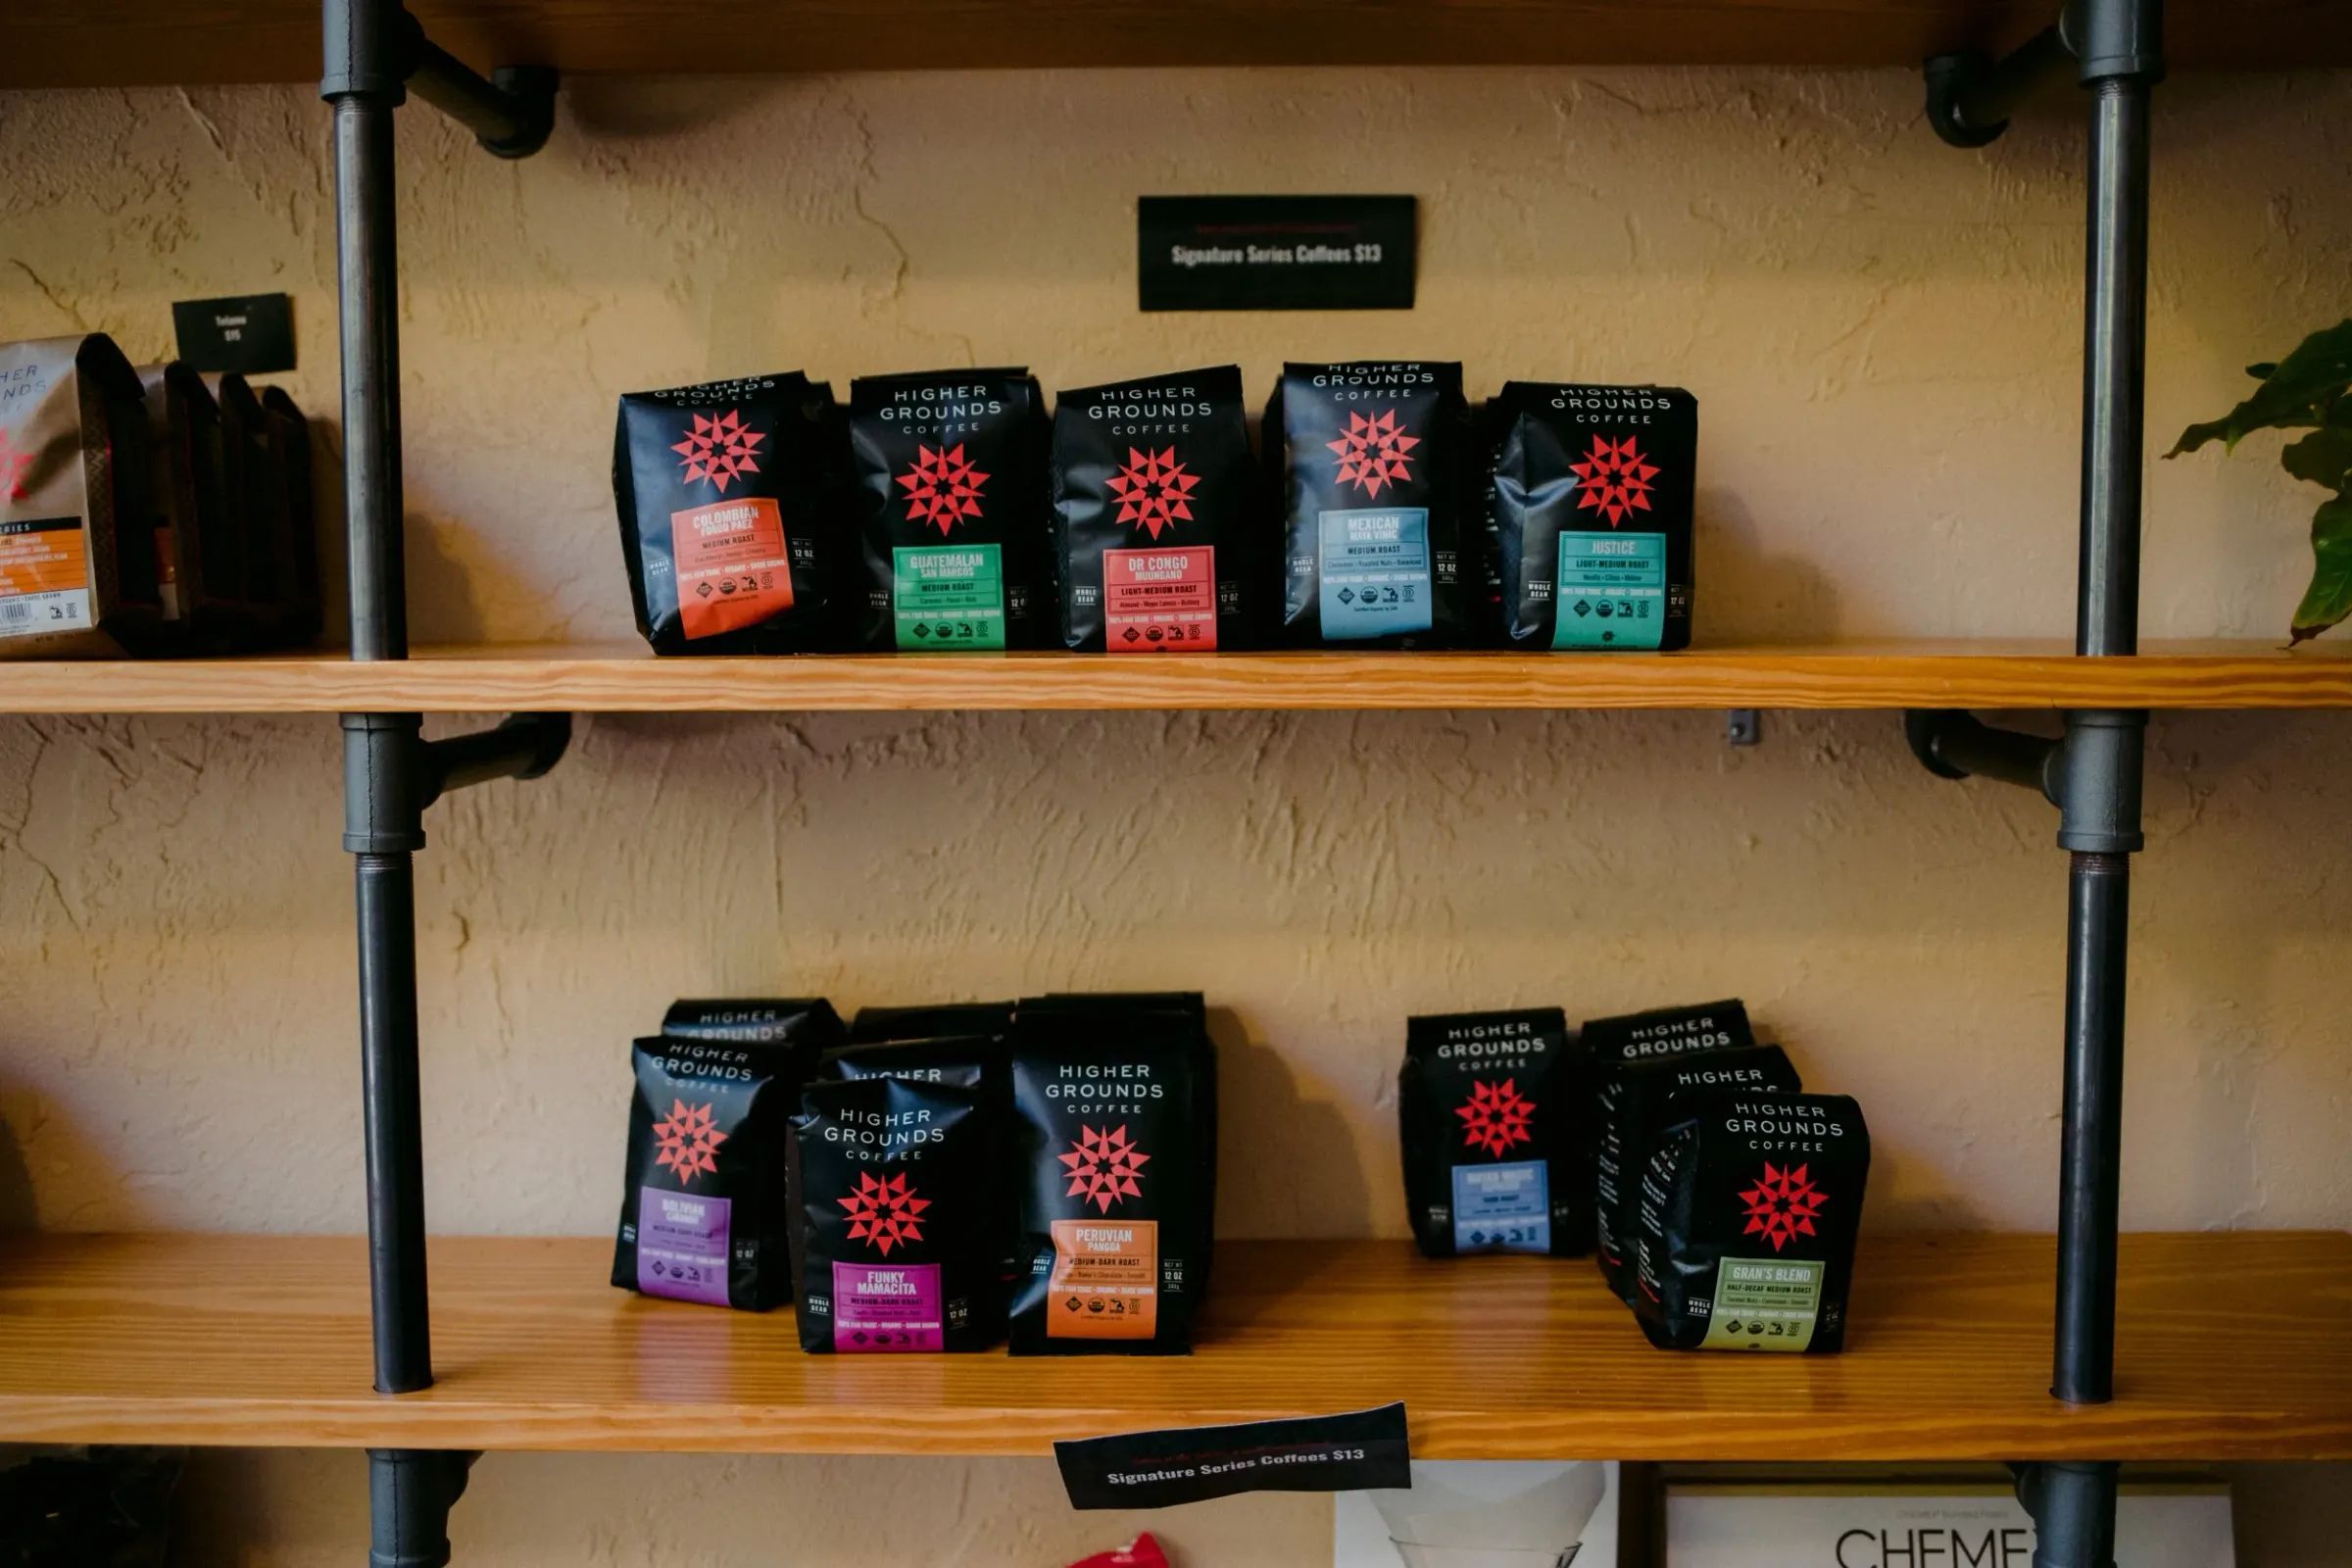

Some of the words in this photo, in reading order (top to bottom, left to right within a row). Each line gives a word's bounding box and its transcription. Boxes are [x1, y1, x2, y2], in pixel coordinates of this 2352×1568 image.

[1172, 246, 1244, 268] Signature
[1247, 245, 1292, 263] Series
[1296, 245, 1350, 263] Coffees
[1354, 244, 1381, 263] $13
[1328, 365, 1420, 374] HIGHER
[678, 376, 760, 391] GHER
[1313, 373, 1434, 387] GROUNDS
[655, 380, 775, 398] GROUNDS
[895, 385, 987, 402] HIGHER
[1102, 387, 1196, 400] HIGHER
[1335, 389, 1411, 401] COFFEE
[677, 393, 753, 406] COFFEE
[1551, 398, 1671, 410] GROUNDS
[880, 401, 1002, 420] GROUNDS
[1088, 403, 1211, 419] GROUNDS
[1576, 415, 1651, 423] COFFEE
[903, 422, 979, 434] COFFEE
[1112, 423, 1191, 435] COFFEE
[692, 507, 760, 528] COLOMBIAN
[731, 518, 754, 531] PAEZ
[1348, 516, 1399, 531] MEXICAN
[703, 538, 730, 549] MEDIUM
[732, 535, 755, 545] ROAST
[1591, 541, 1637, 555] JUSTICE
[804, 549, 813, 558] OZ
[1348, 546, 1376, 555] MEDIUM
[1378, 545, 1400, 554] ROAST
[910, 554, 983, 568] GUATEMALAN
[1129, 558, 1144, 571] DR
[1148, 556, 1188, 570] CONGO
[1438, 564, 1446, 572] 12
[1447, 564, 1456, 572] OZ
[1576, 560, 1627, 568] LIGHT-MEDIUM
[1628, 561, 1649, 569] ROAST
[939, 566, 974, 577] MARCOS
[921, 583, 951, 592] MEDIUM
[953, 582, 974, 591] ROAST
[1121, 586, 1173, 596] LIGHT-MEDIUM
[1175, 585, 1198, 594] ROAST
[1011, 599, 1019, 608] 12
[1220, 594, 1228, 603] 12
[700, 1010, 776, 1024] HIGHER
[1448, 1022, 1531, 1040] HIGHER
[1632, 1017, 1714, 1040] HIGHER
[1438, 1038, 1545, 1058] GROUNDS
[1623, 1032, 1731, 1057] GROUNDS
[669, 1045, 749, 1062] HIGHER
[651, 1055, 753, 1082] GROUNDS
[1059, 1064, 1151, 1078] HIGHER
[1458, 1058, 1526, 1071] COFFEE
[1678, 1069, 1763, 1085] HIGHER
[664, 1078, 729, 1094] COFFEE
[1046, 1084, 1163, 1098] GROUNDS
[1067, 1104, 1142, 1113] COFFEE
[1736, 1102, 1826, 1117] HIGHER
[841, 1108, 930, 1127] HIGHER
[1726, 1119, 1843, 1136] GROUNDS
[824, 1127, 944, 1147] GROUNDS
[1749, 1140, 1823, 1152] COFFEE
[846, 1150, 921, 1161] COFFEE
[1076, 1229, 1133, 1242] PERUVIAN
[1088, 1242, 1121, 1251] PANGOA
[867, 1271, 905, 1283] FUNKY
[1733, 1266, 1772, 1280] GRAN'S
[1776, 1269, 1811, 1282] BLEND
[858, 1283, 916, 1295] MAMACITA
[1727, 1284, 1764, 1293] HALF-DECAF
[808, 1298, 830, 1306] WHOLE
[1689, 1299, 1711, 1308] WHOLE
[958, 1308, 967, 1317] OZ
[1107, 1466, 1195, 1486] Signature
[1200, 1458, 1256, 1476] Series
[1260, 1450, 1328, 1466] Coffees
[1333, 1448, 1365, 1461] $13
[1836, 1529, 2029, 1568] CHEME
